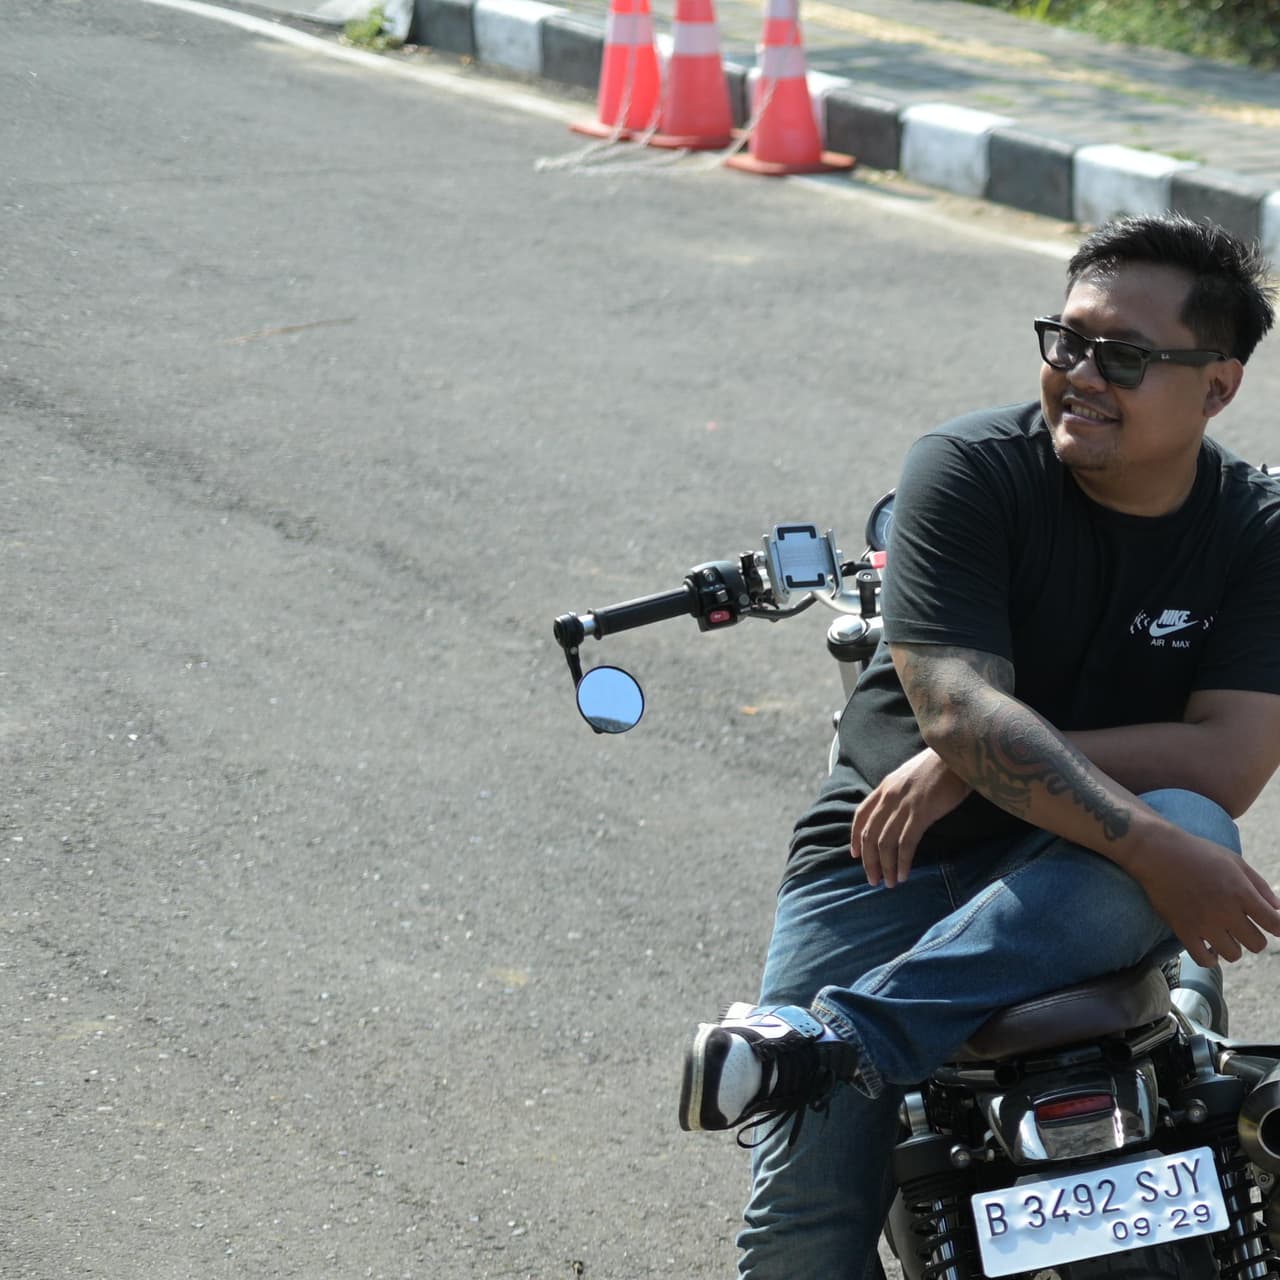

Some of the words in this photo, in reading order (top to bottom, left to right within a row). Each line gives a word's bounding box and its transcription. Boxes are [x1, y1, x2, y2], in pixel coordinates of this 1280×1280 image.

[1158, 609, 1191, 625] NIKE
[1151, 638, 1165, 647] AIR
[1172, 640, 1190, 648] MAX
[985, 1202, 1009, 1238] B
[1024, 1178, 1120, 1229] 3492
[1135, 1157, 1202, 1203] SJY
